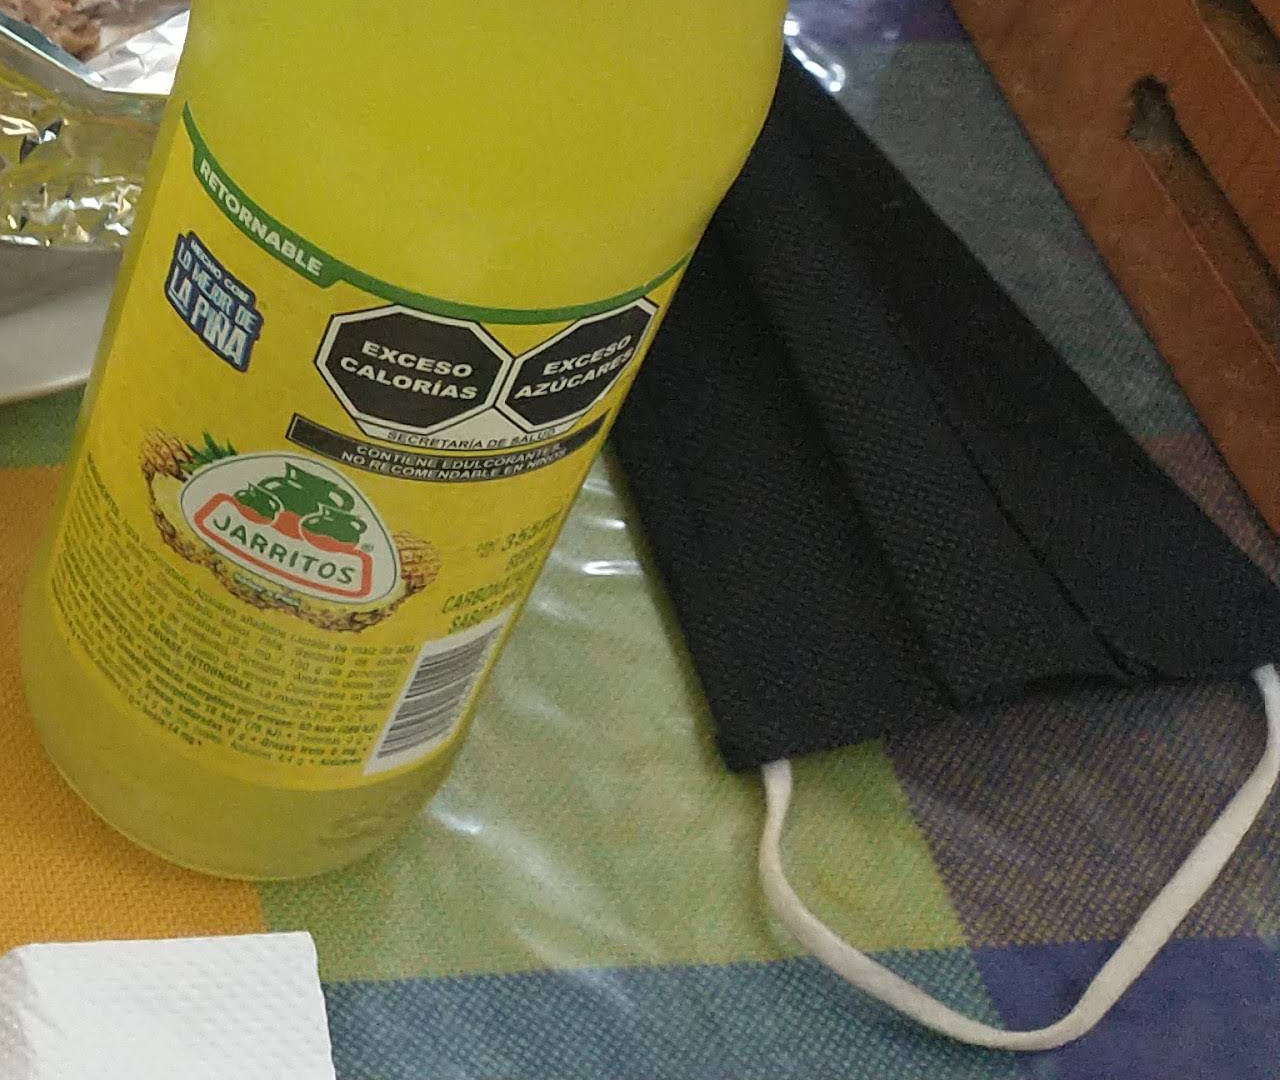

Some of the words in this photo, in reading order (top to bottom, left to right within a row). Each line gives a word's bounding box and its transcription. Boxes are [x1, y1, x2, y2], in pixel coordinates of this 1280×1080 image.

[199, 158, 324, 277] RETORNABLE
[169, 266, 192, 307] LA
[235, 303, 258, 332] DE
[361, 340, 473, 378] EXCESO
[513, 346, 637, 400] AZÚCARES
[542, 334, 633, 377] EXCESO
[339, 356, 479, 401] CALORÍAS
[356, 445, 441, 469] CONTIENE
[386, 430, 482, 450] SECRETARÍA
[487, 437, 507, 449] DE
[510, 427, 556, 446] SALUD
[340, 450, 367, 466] NO
[368, 460, 502, 480] RECOMENDABLE
[503, 463, 523, 476] EN
[212, 515, 356, 586] JARRITOS
